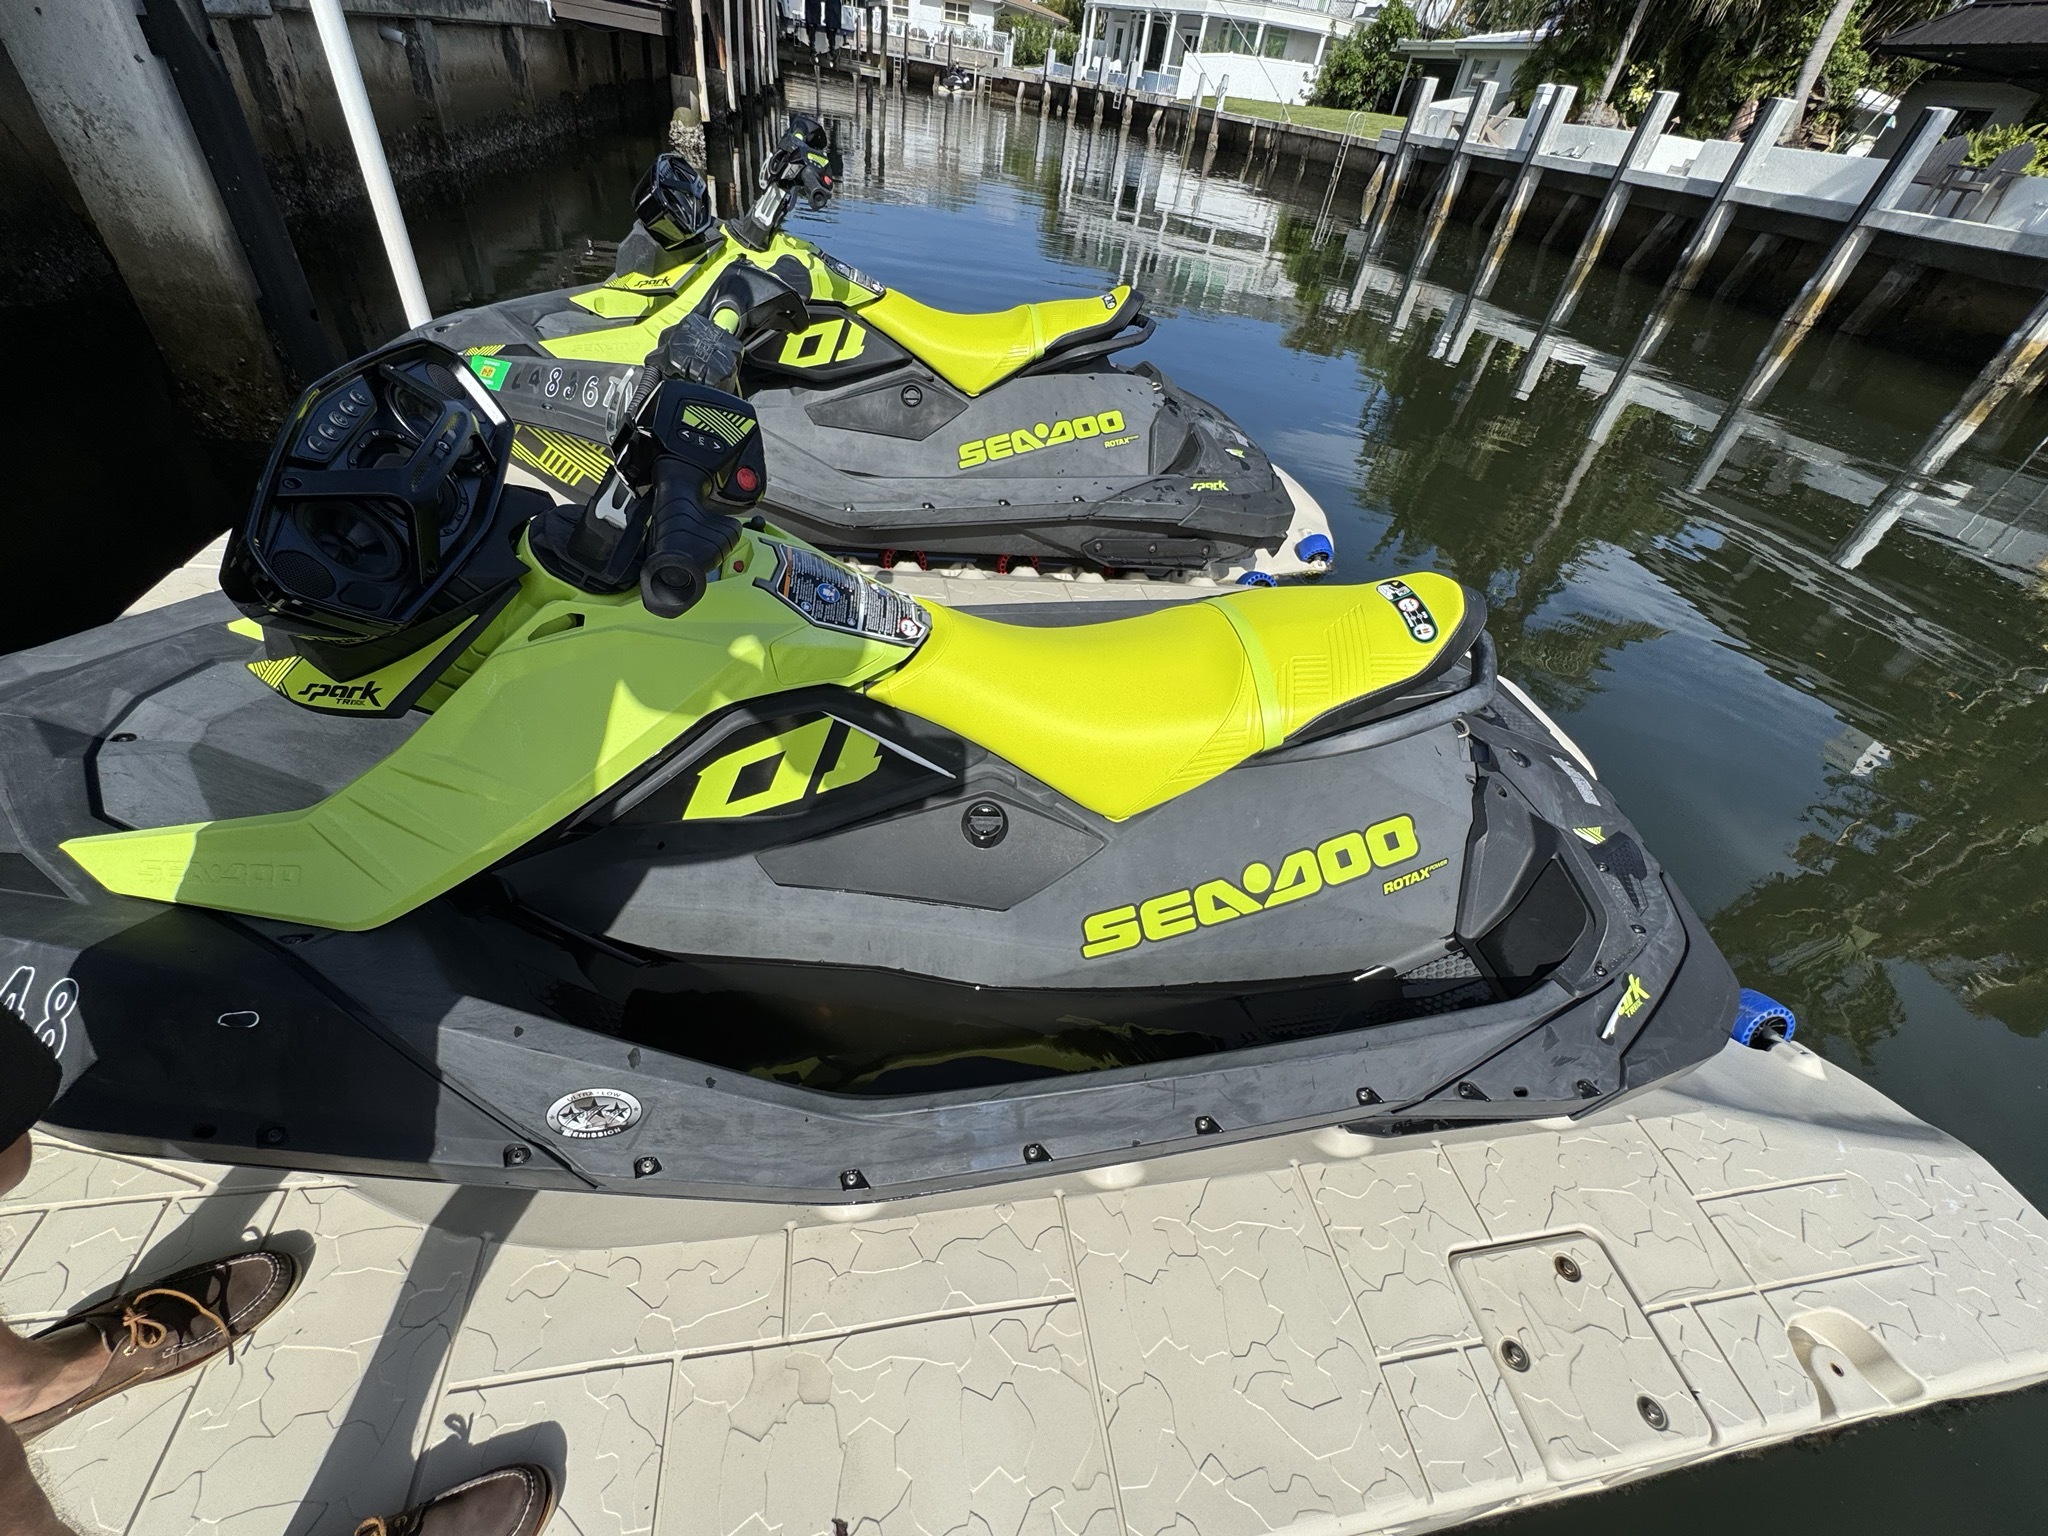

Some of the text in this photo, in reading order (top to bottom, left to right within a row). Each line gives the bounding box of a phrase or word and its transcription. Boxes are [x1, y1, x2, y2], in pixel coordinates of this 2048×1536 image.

[634, 276, 671, 288] spark
[1104, 437, 1130, 449] ROTAX
[1190, 480, 1229, 491] spark
[298, 681, 383, 707] spark
[1383, 867, 1430, 895] ROTAX
